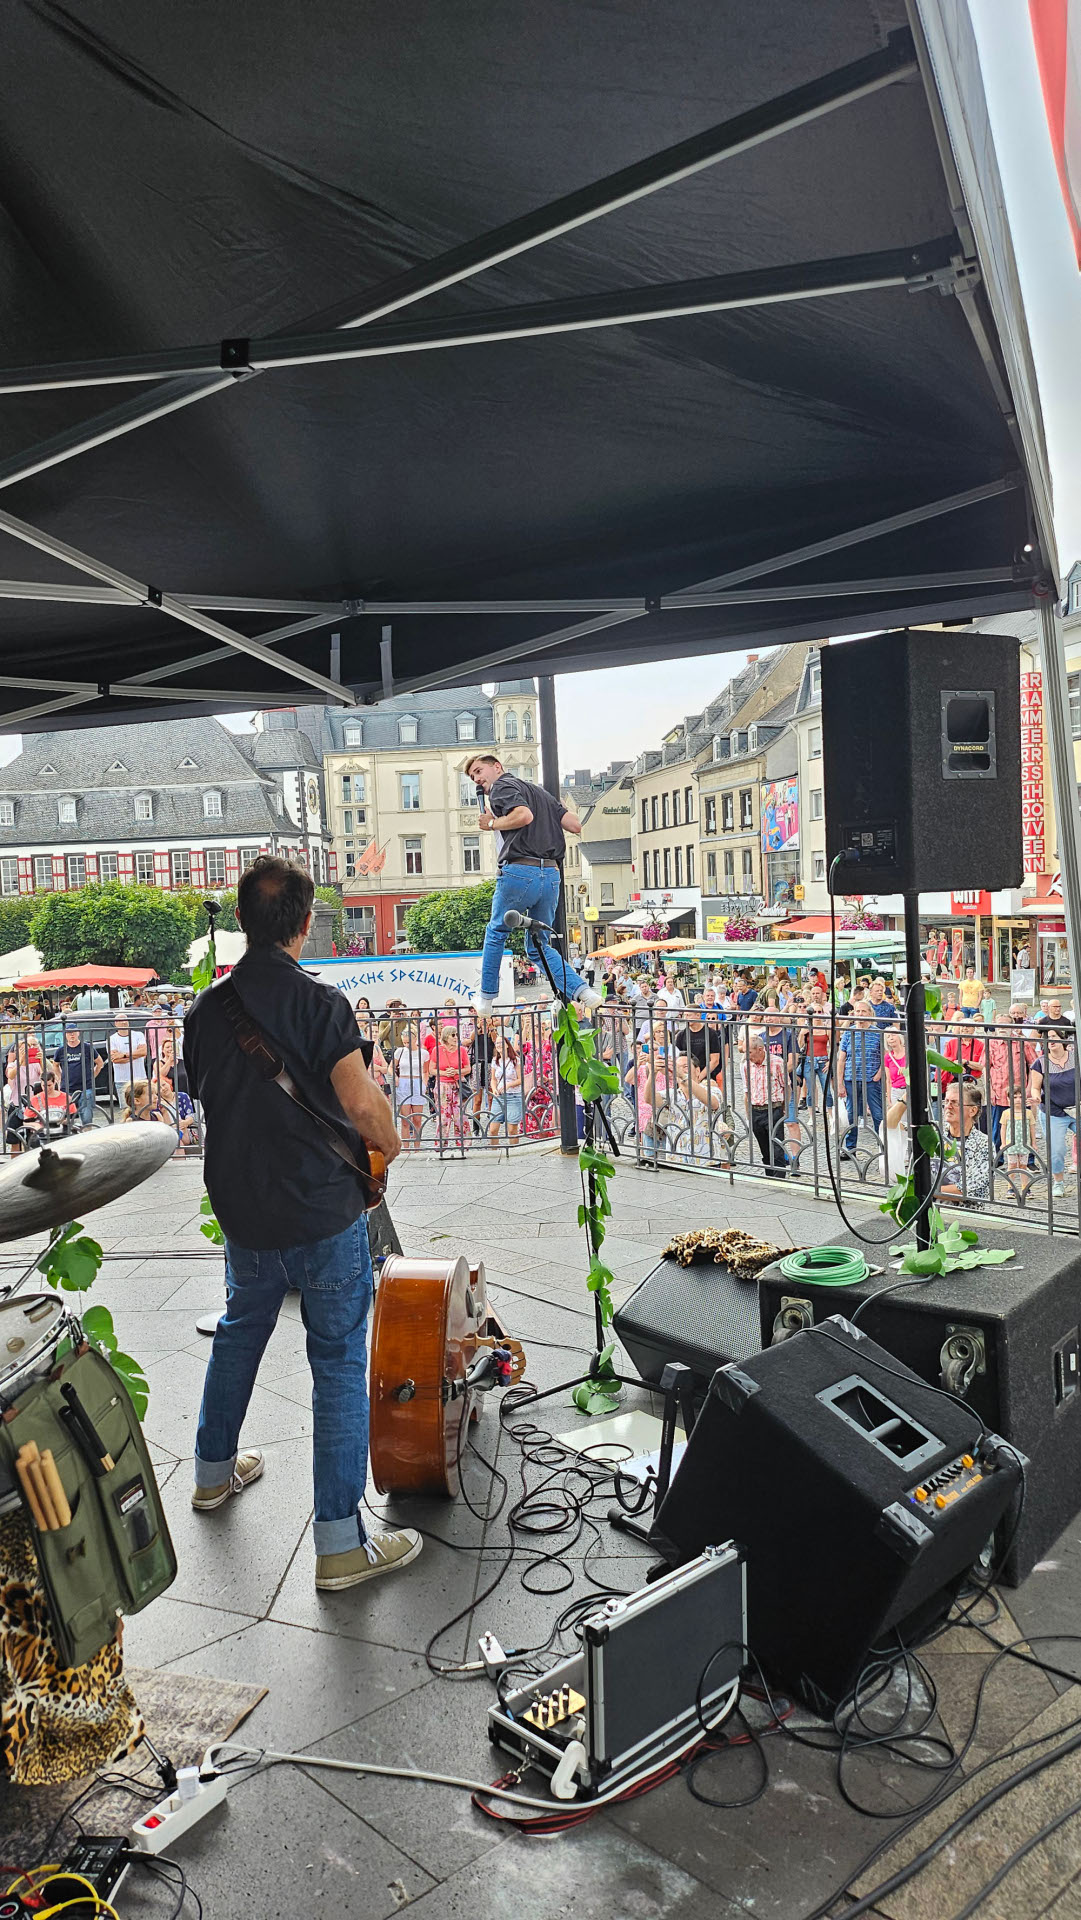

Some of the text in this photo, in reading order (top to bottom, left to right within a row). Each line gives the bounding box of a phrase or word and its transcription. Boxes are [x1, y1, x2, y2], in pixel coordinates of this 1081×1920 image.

[1030, 673, 1044, 872] RAMERSHOVEN
[337, 968, 477, 1000] HISCHE SPEZIALITÄTE
